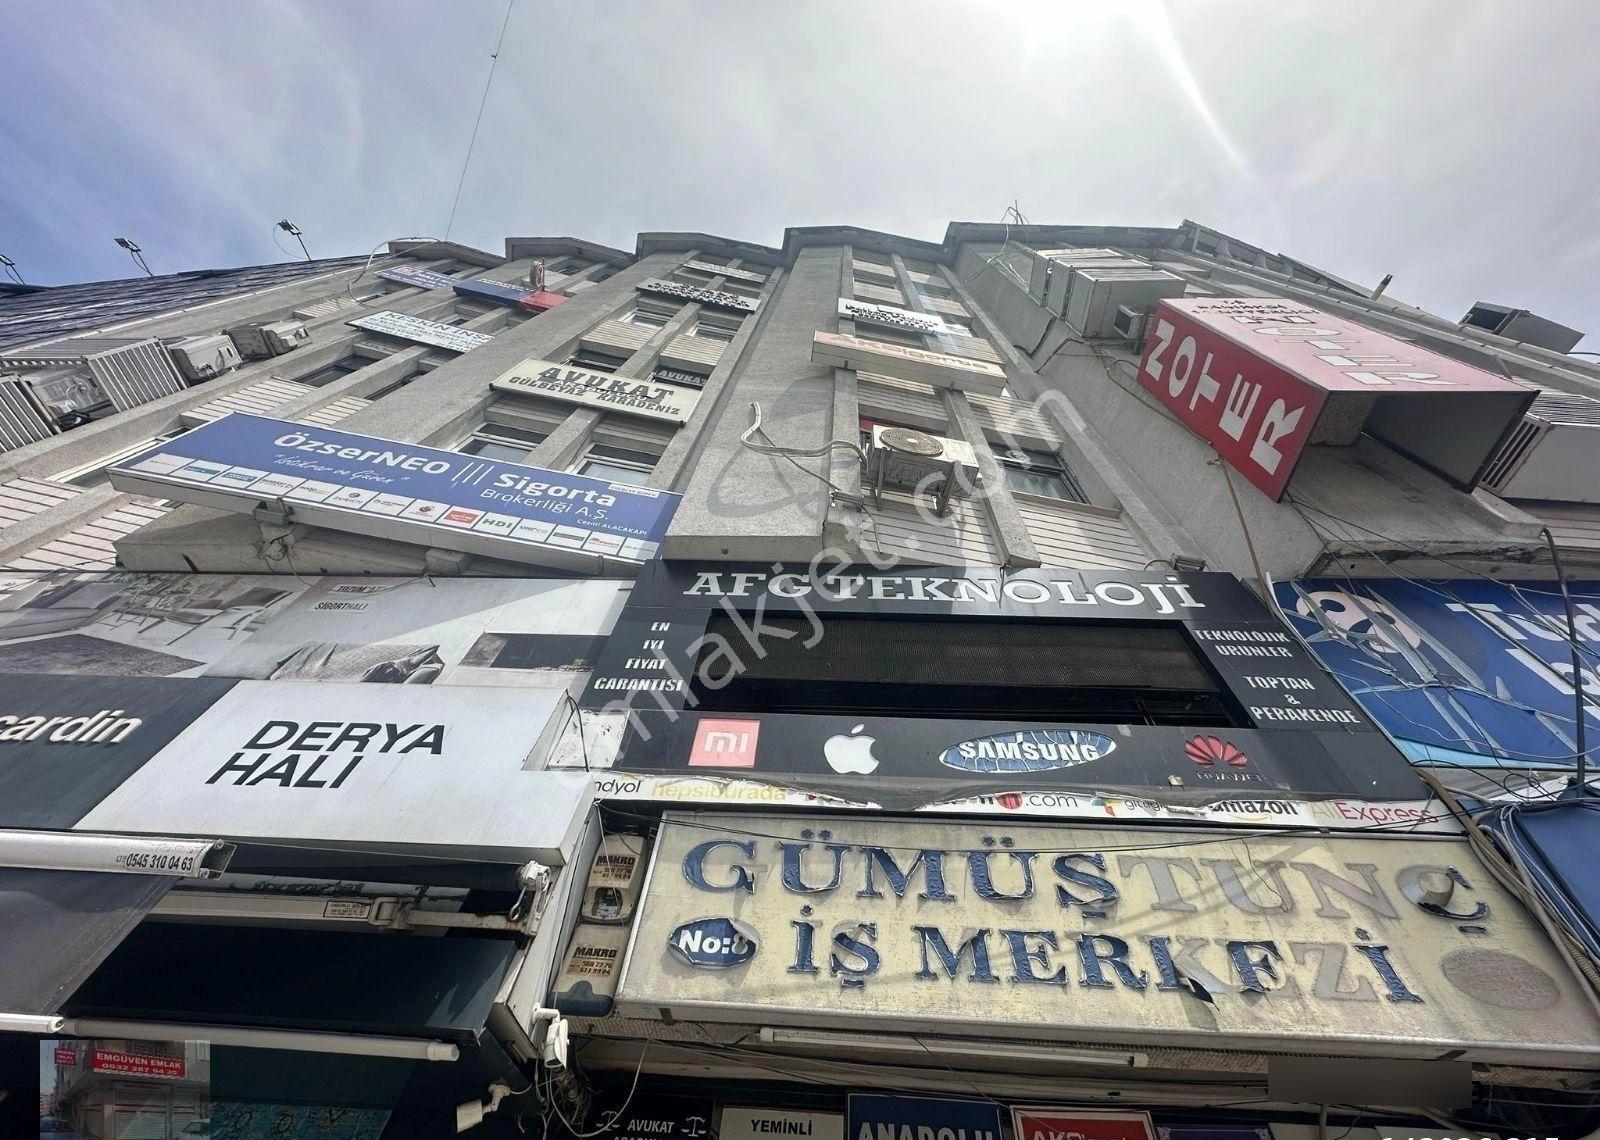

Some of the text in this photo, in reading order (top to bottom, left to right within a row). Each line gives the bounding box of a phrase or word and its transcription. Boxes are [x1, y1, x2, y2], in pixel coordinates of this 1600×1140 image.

[538, 367, 674, 404] AVUKAT
[1145, 319, 1305, 476] ZOTER
[273, 431, 451, 474] ÖzserNEO
[480, 488, 570, 513] Brokerliği
[494, 472, 616, 507] Sigorta
[482, 518, 513, 528] HDI
[682, 571, 812, 598] AFG
[650, 621, 671, 632] EN
[1243, 676, 1316, 690] TOPTAN
[1249, 706, 1362, 724] PERAKENDE
[242, 719, 445, 755] DERYA
[958, 736, 1102, 763] SAMSUNG
[205, 752, 364, 789] HALI
[126, 853, 149, 868] 0545
[149, 854, 167, 869] 310
[168, 855, 181, 870] 04
[182, 857, 193, 871] 63
[573, 946, 618, 959] MAKRO
[787, 903, 881, 989] İŞ
[627, 1119, 675, 1133] AVUKAT
[750, 1118, 813, 1136] YEMİNLİ
